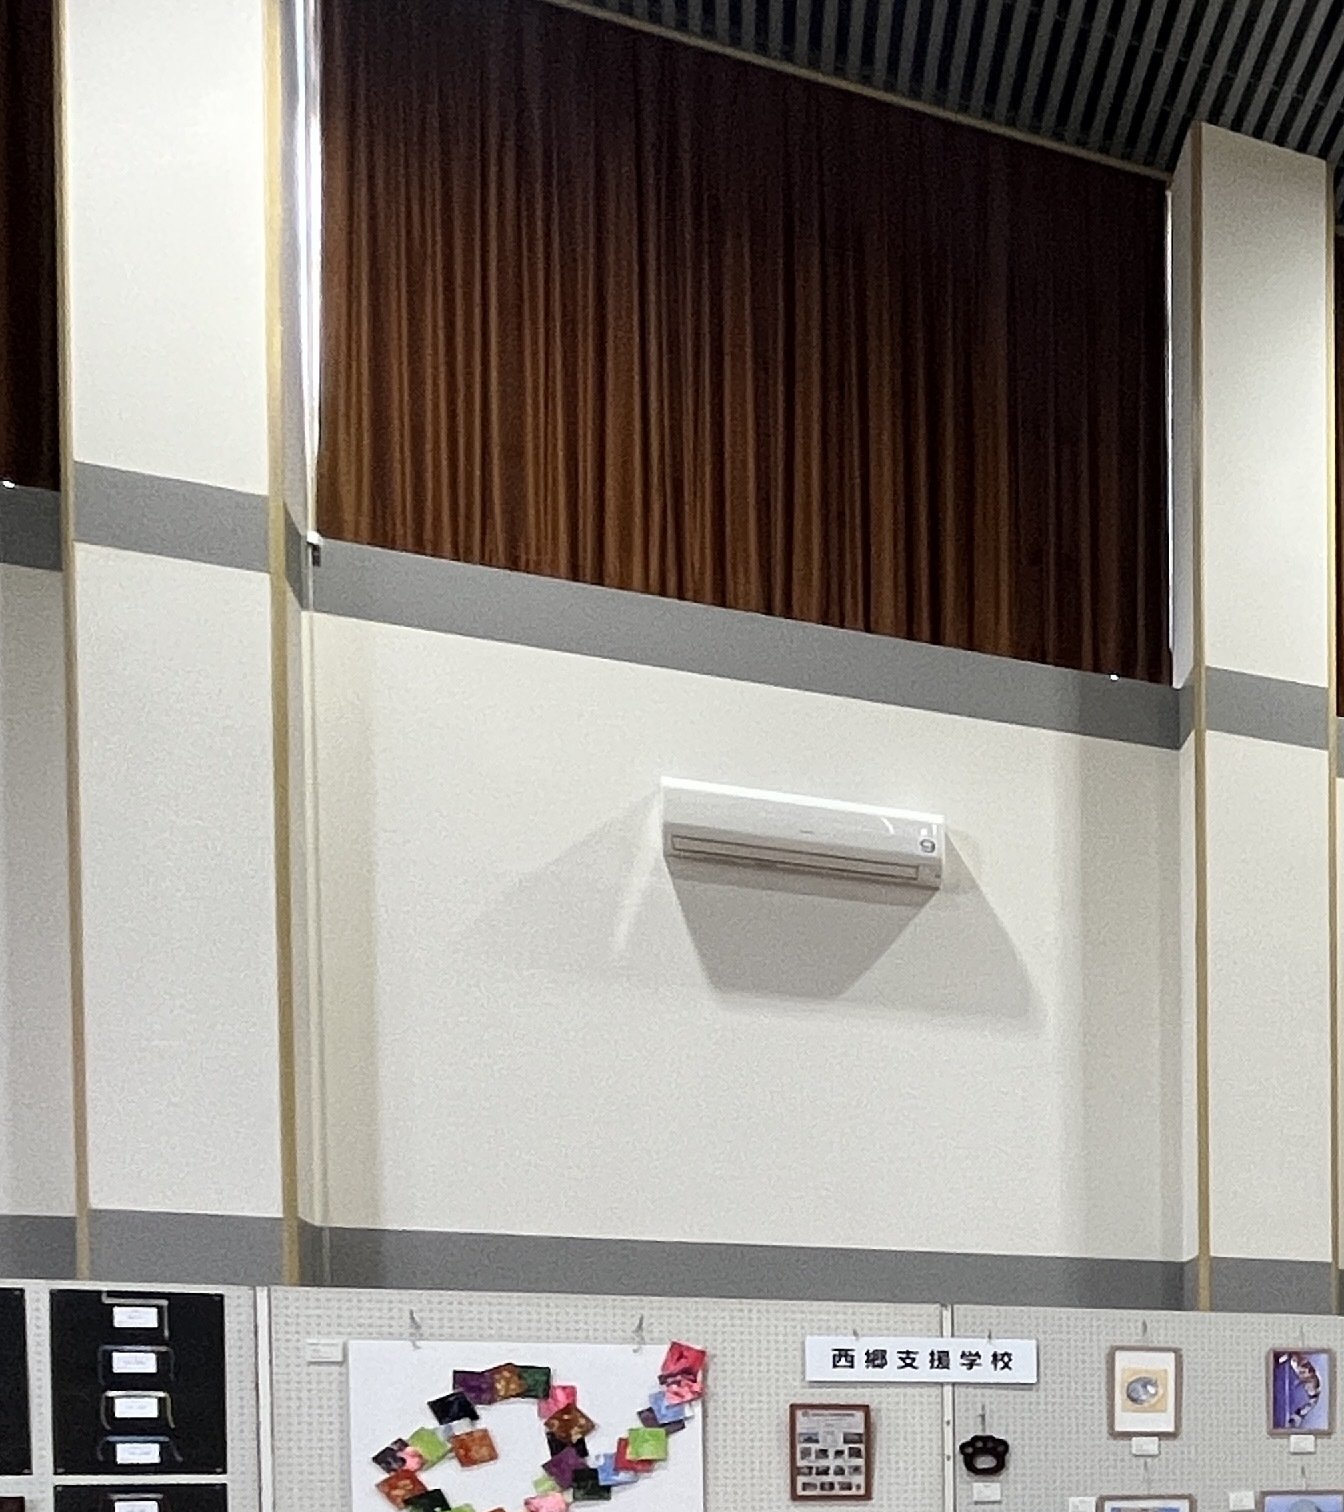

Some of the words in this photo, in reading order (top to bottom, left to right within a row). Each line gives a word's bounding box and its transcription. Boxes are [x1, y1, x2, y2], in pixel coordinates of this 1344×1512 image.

[831, 1348, 1013, 1371] 西郷支援学校
